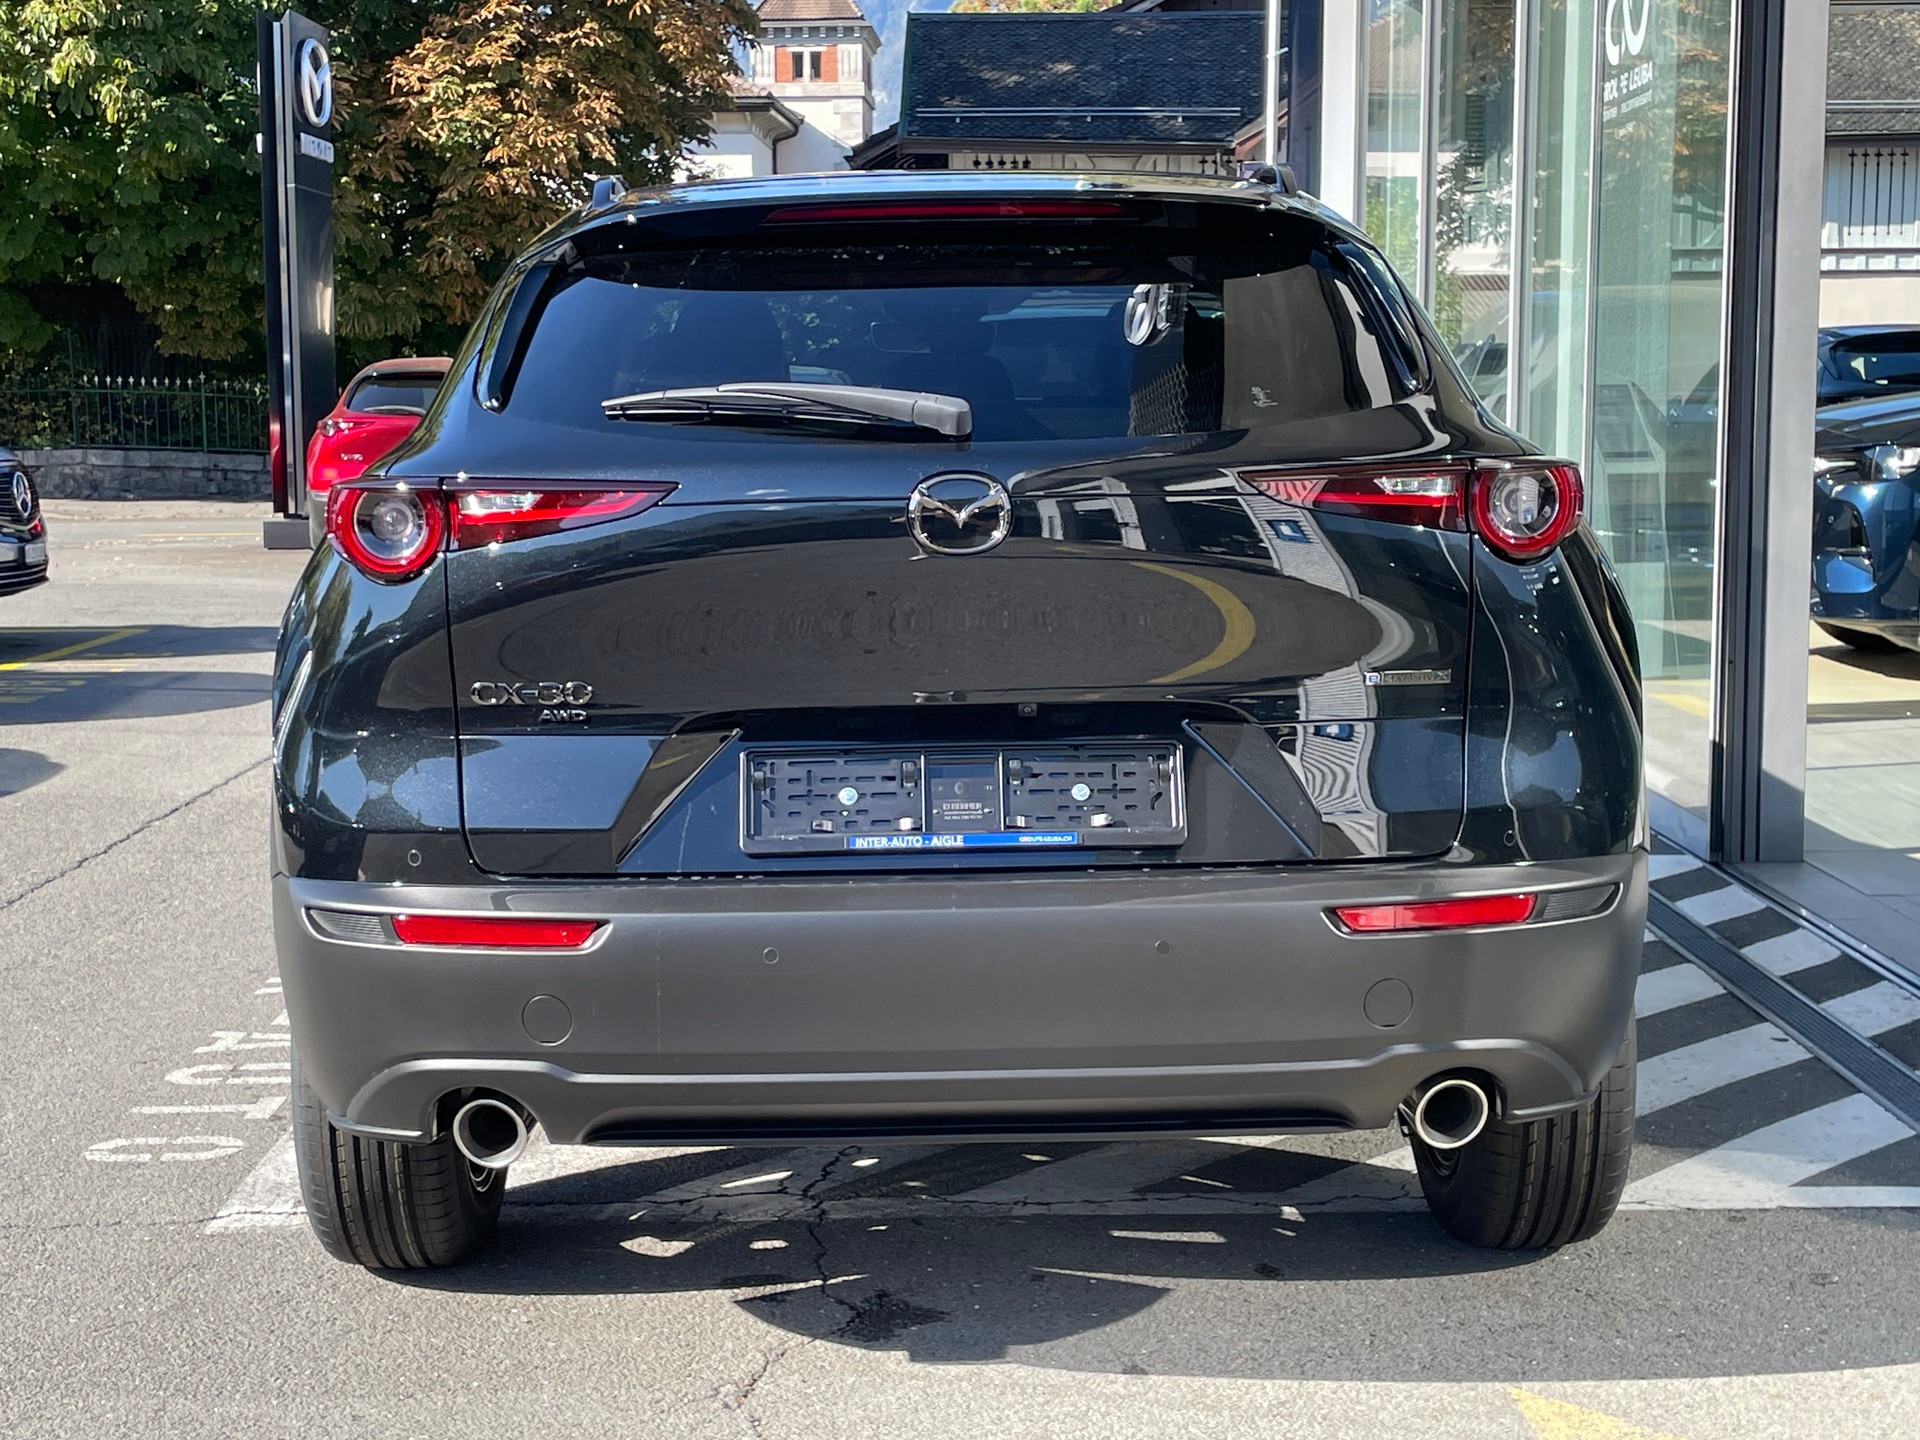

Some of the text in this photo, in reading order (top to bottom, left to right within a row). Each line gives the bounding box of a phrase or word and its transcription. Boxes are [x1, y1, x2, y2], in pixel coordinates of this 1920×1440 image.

[1384, 672, 1432, 684] SKYACTIV
[470, 681, 594, 706] CX-30
[538, 709, 587, 722] AWD
[855, 836, 922, 848] INTER-AUTO
[930, 835, 964, 846] AIGLE
